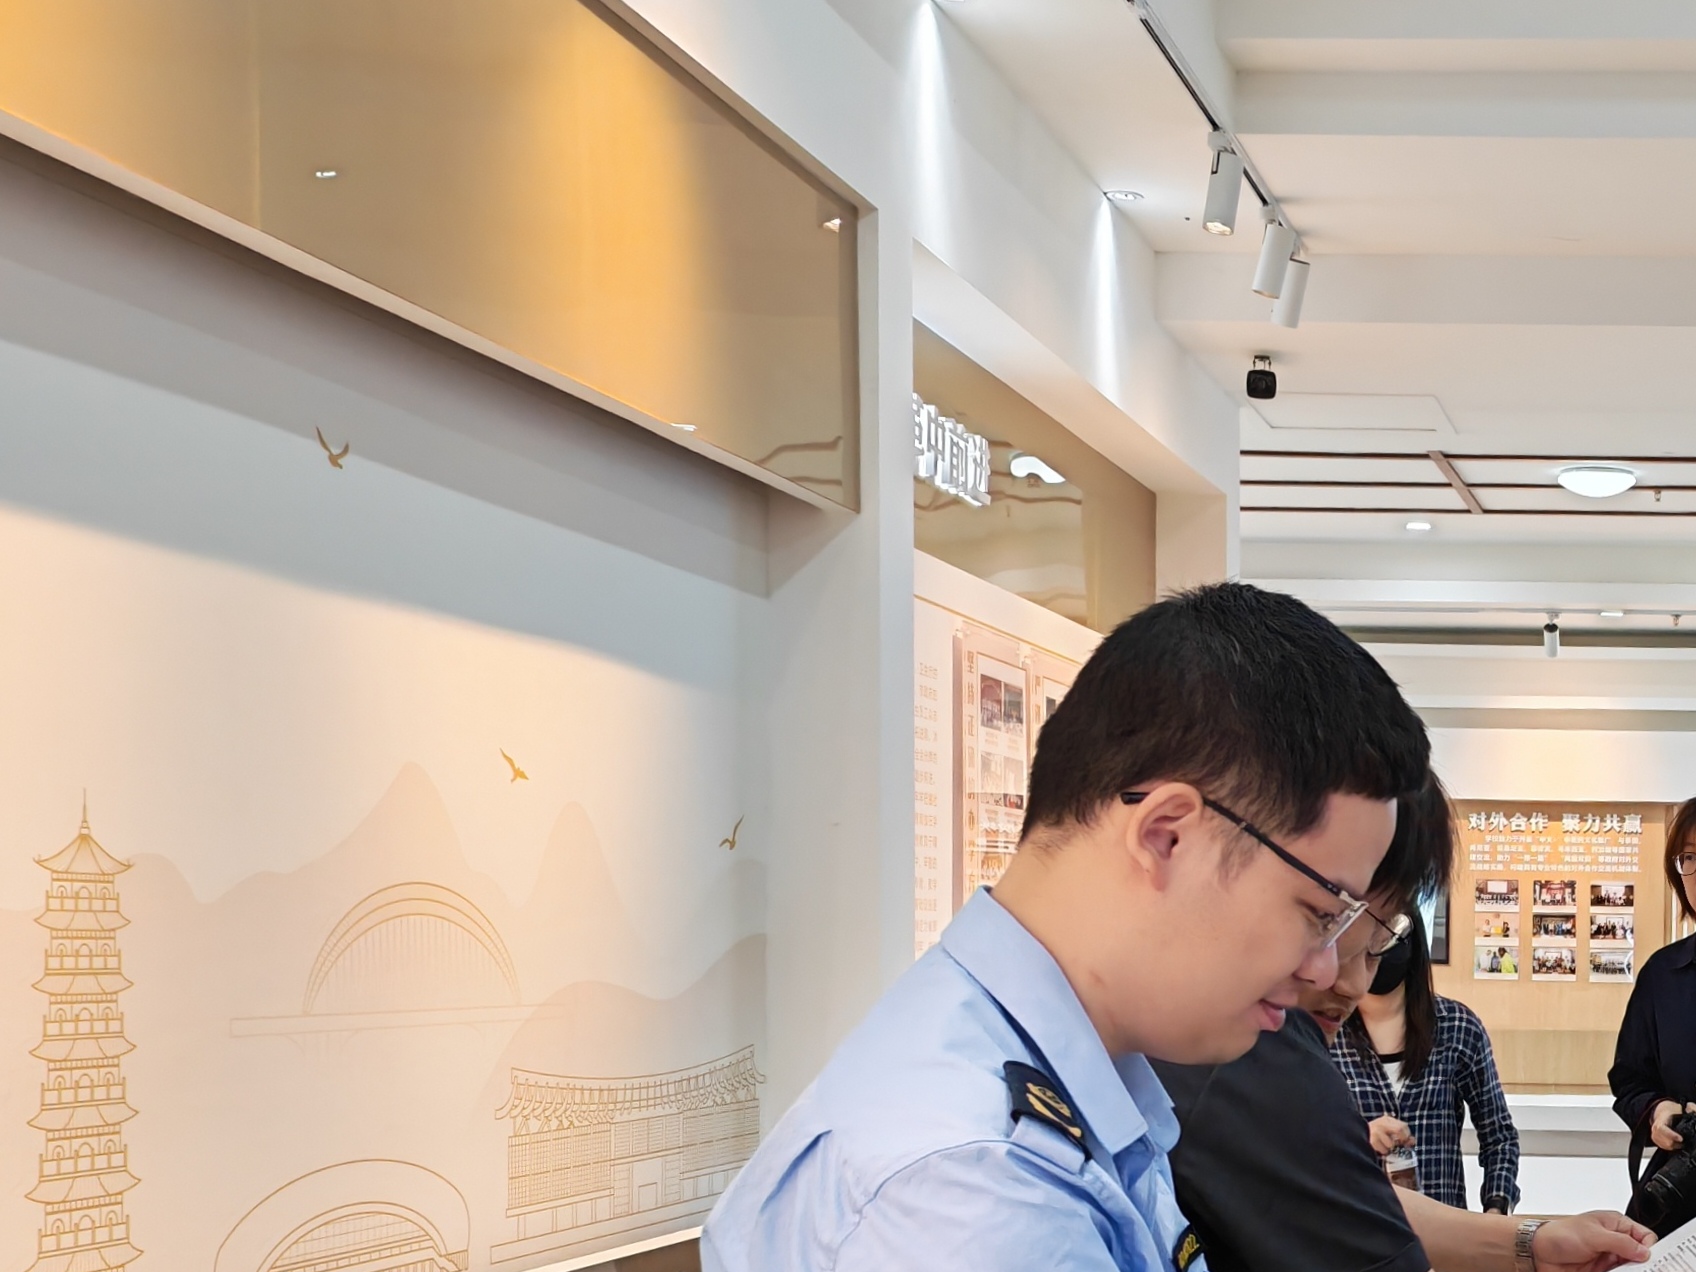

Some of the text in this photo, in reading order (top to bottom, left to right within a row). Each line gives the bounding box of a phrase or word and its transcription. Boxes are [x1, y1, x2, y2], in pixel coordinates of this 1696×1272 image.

[1468, 811, 1643, 834] 对外合作 聚力共赢
